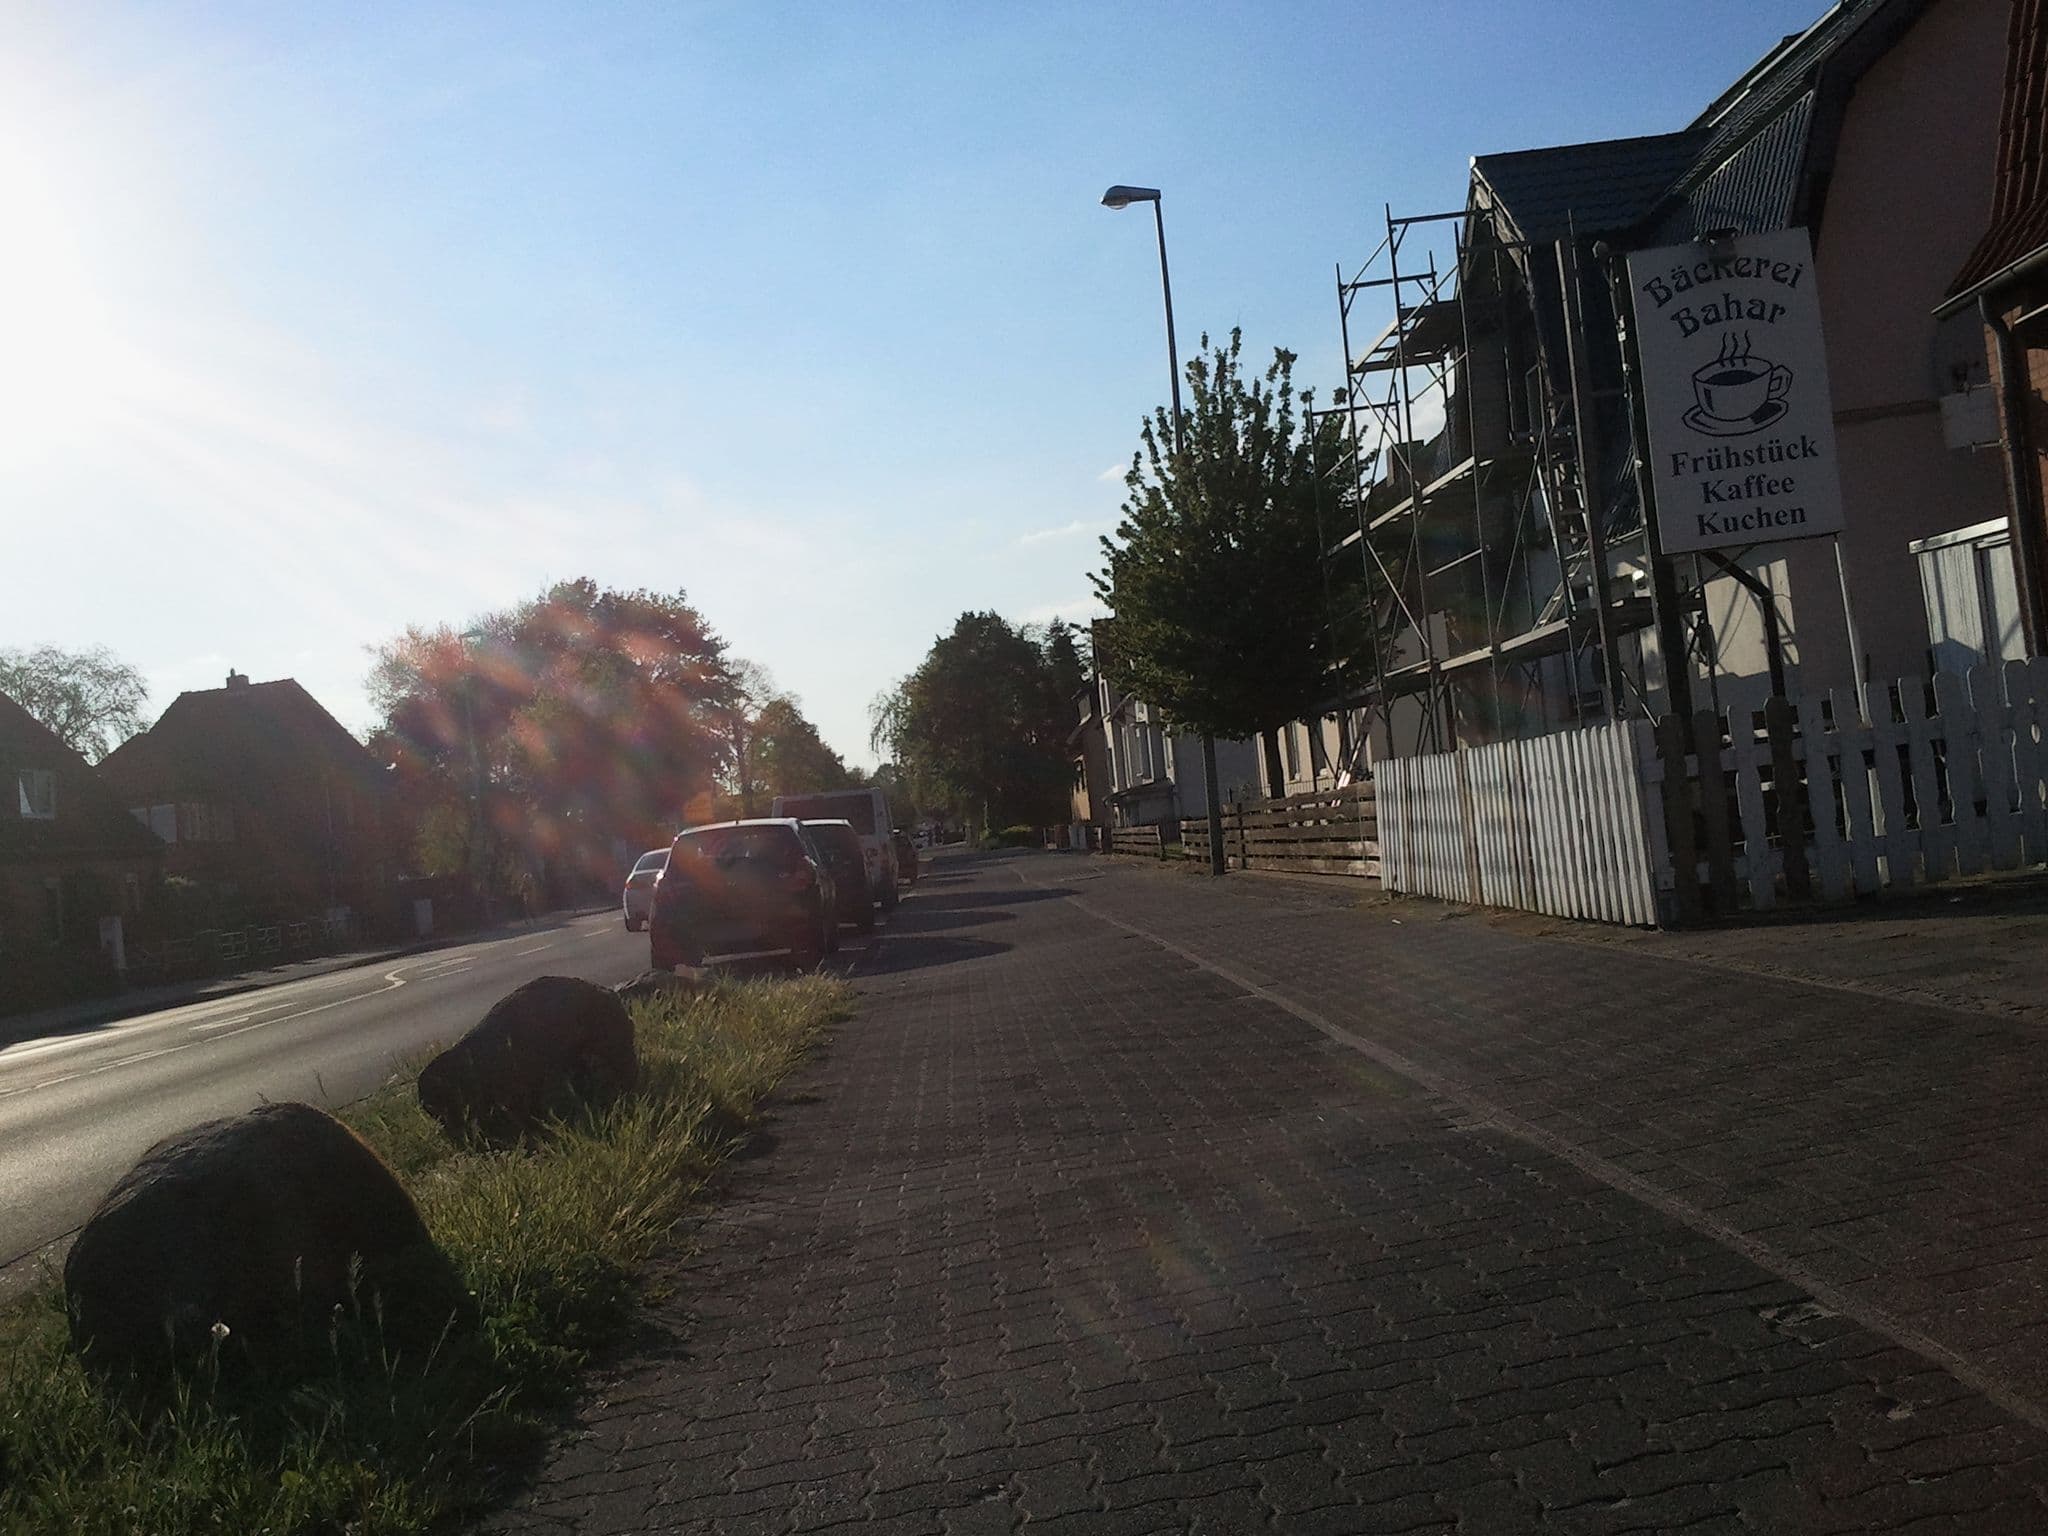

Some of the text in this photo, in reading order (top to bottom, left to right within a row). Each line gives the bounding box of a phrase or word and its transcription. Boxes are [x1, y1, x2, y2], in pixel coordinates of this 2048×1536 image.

[1642, 256, 1802, 308] Bäckerei
[1670, 293, 1786, 338] Bahar
[1671, 435, 1819, 477] Frühstück
[1702, 475, 1796, 504] Kaffee
[1697, 507, 1807, 537] Kuchen
